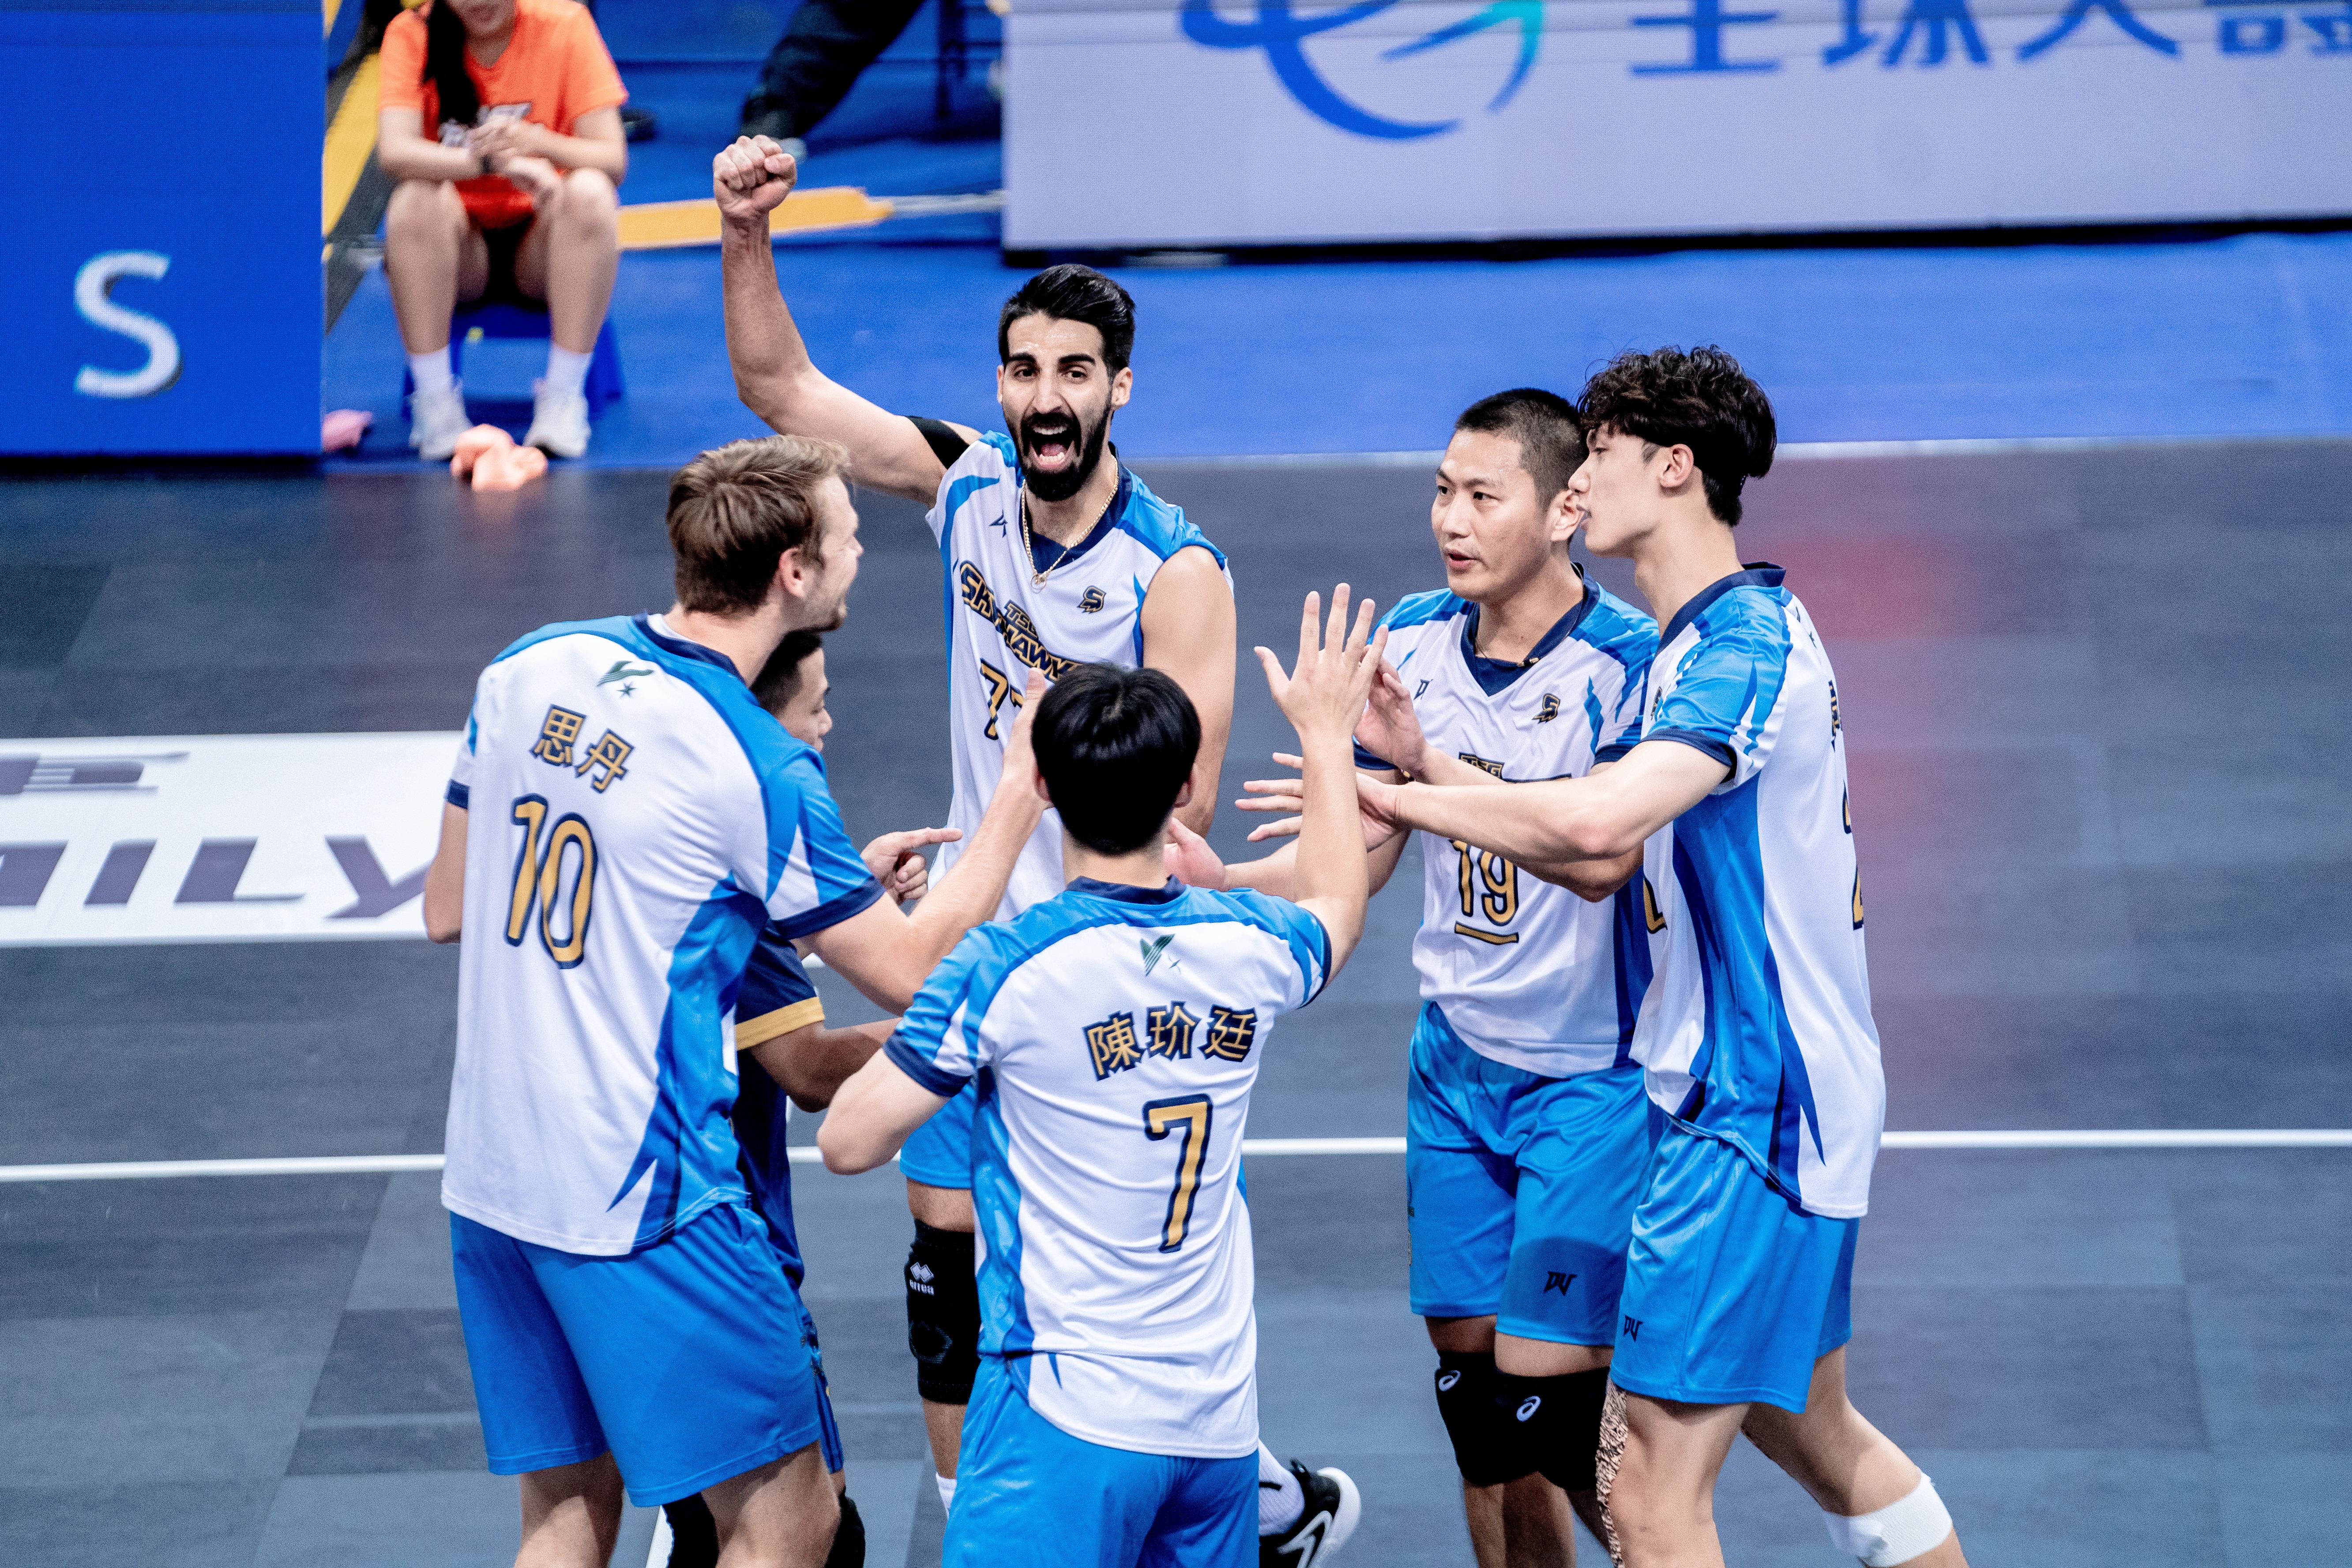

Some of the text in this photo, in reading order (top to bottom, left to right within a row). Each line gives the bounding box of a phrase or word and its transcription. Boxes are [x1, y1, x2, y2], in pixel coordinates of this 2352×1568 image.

[74, 249, 184, 399] S
[980, 658, 1026, 741] 7
[530, 704, 635, 793] 思丹
[504, 793, 598, 970] 10
[1449, 839, 1519, 926] 19
[1082, 1000, 1259, 1082] 陳玠廷
[1143, 1093, 1214, 1254] 7
